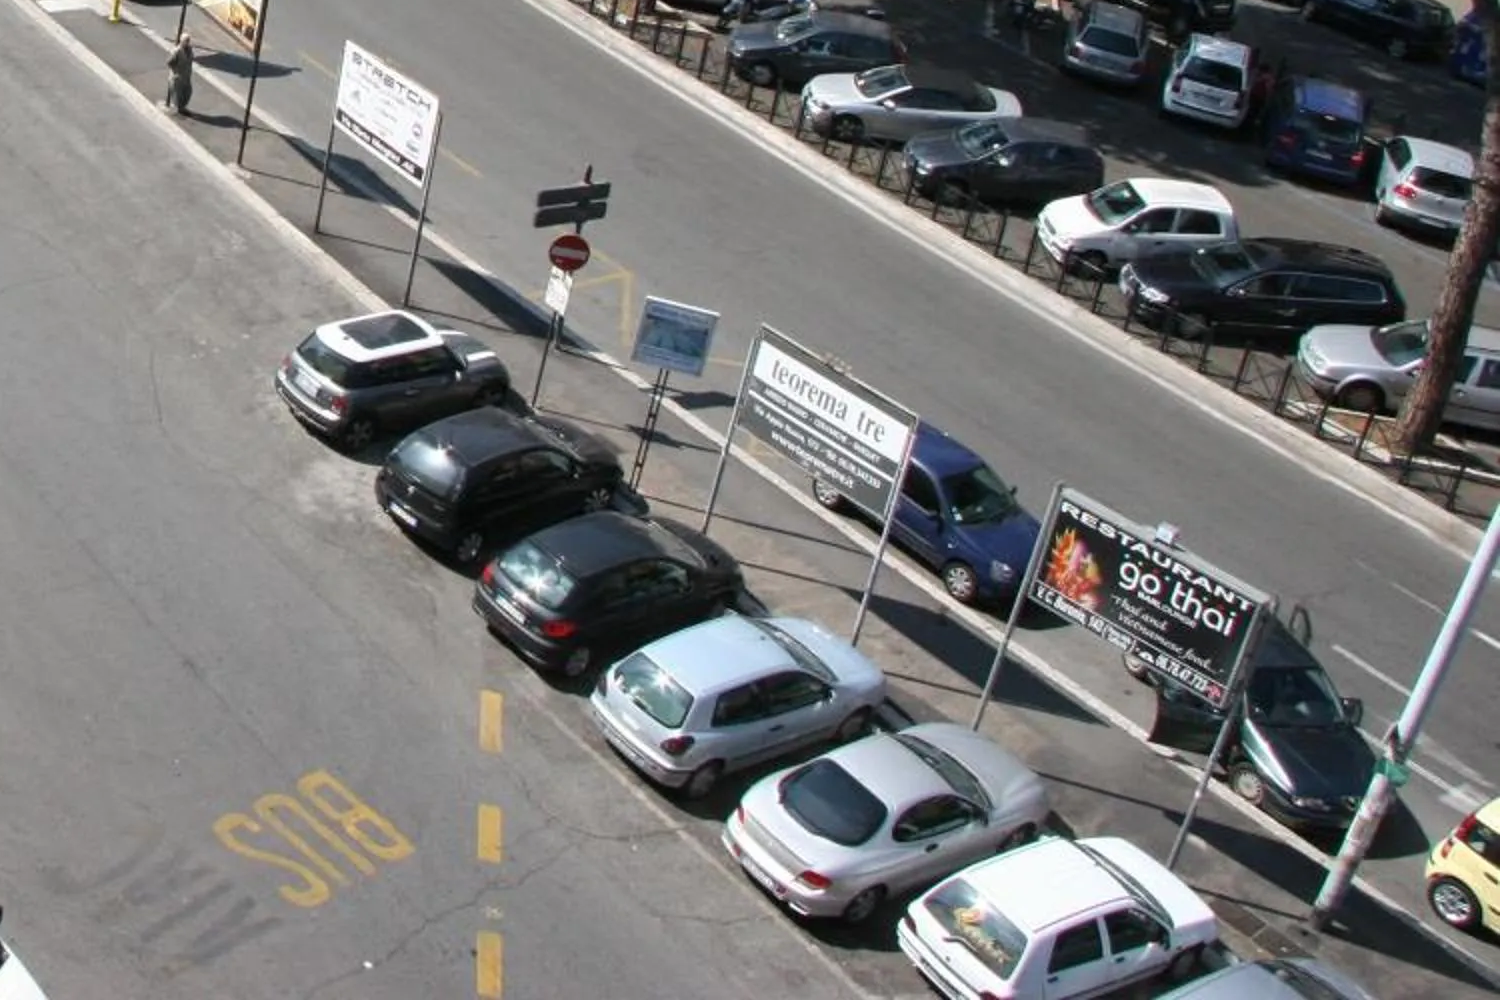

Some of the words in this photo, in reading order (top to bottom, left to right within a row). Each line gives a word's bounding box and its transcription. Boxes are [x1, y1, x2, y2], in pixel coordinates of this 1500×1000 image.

[352, 51, 431, 111] STRETCH
[771, 359, 848, 421] teorema
[857, 410, 885, 443] tre
[1060, 500, 1256, 612] RESTAURANT
[1118, 561, 1162, 595] go
[1170, 580, 1238, 637] thai
[212, 768, 416, 908] BUS
